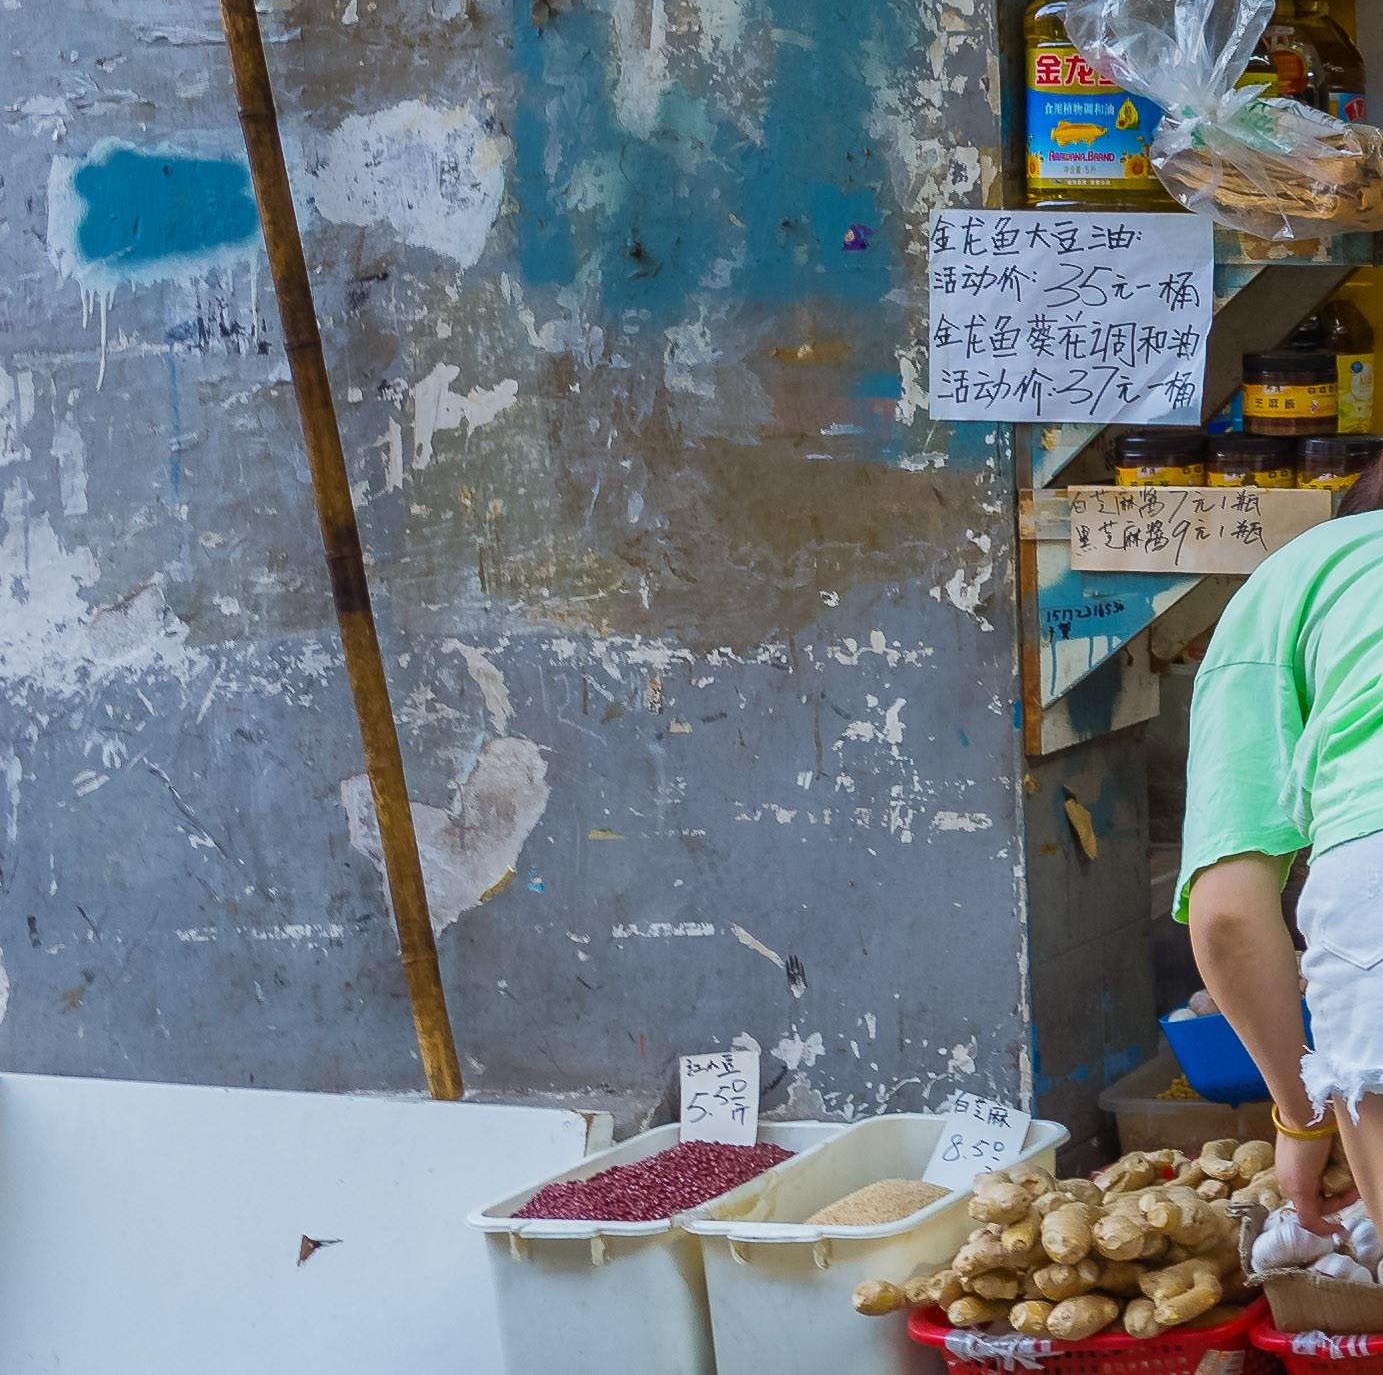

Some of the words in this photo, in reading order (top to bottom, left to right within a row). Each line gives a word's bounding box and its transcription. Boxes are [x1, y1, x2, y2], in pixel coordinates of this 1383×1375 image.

[932, 310, 1201, 368] 金龙鱼葵花调和油
